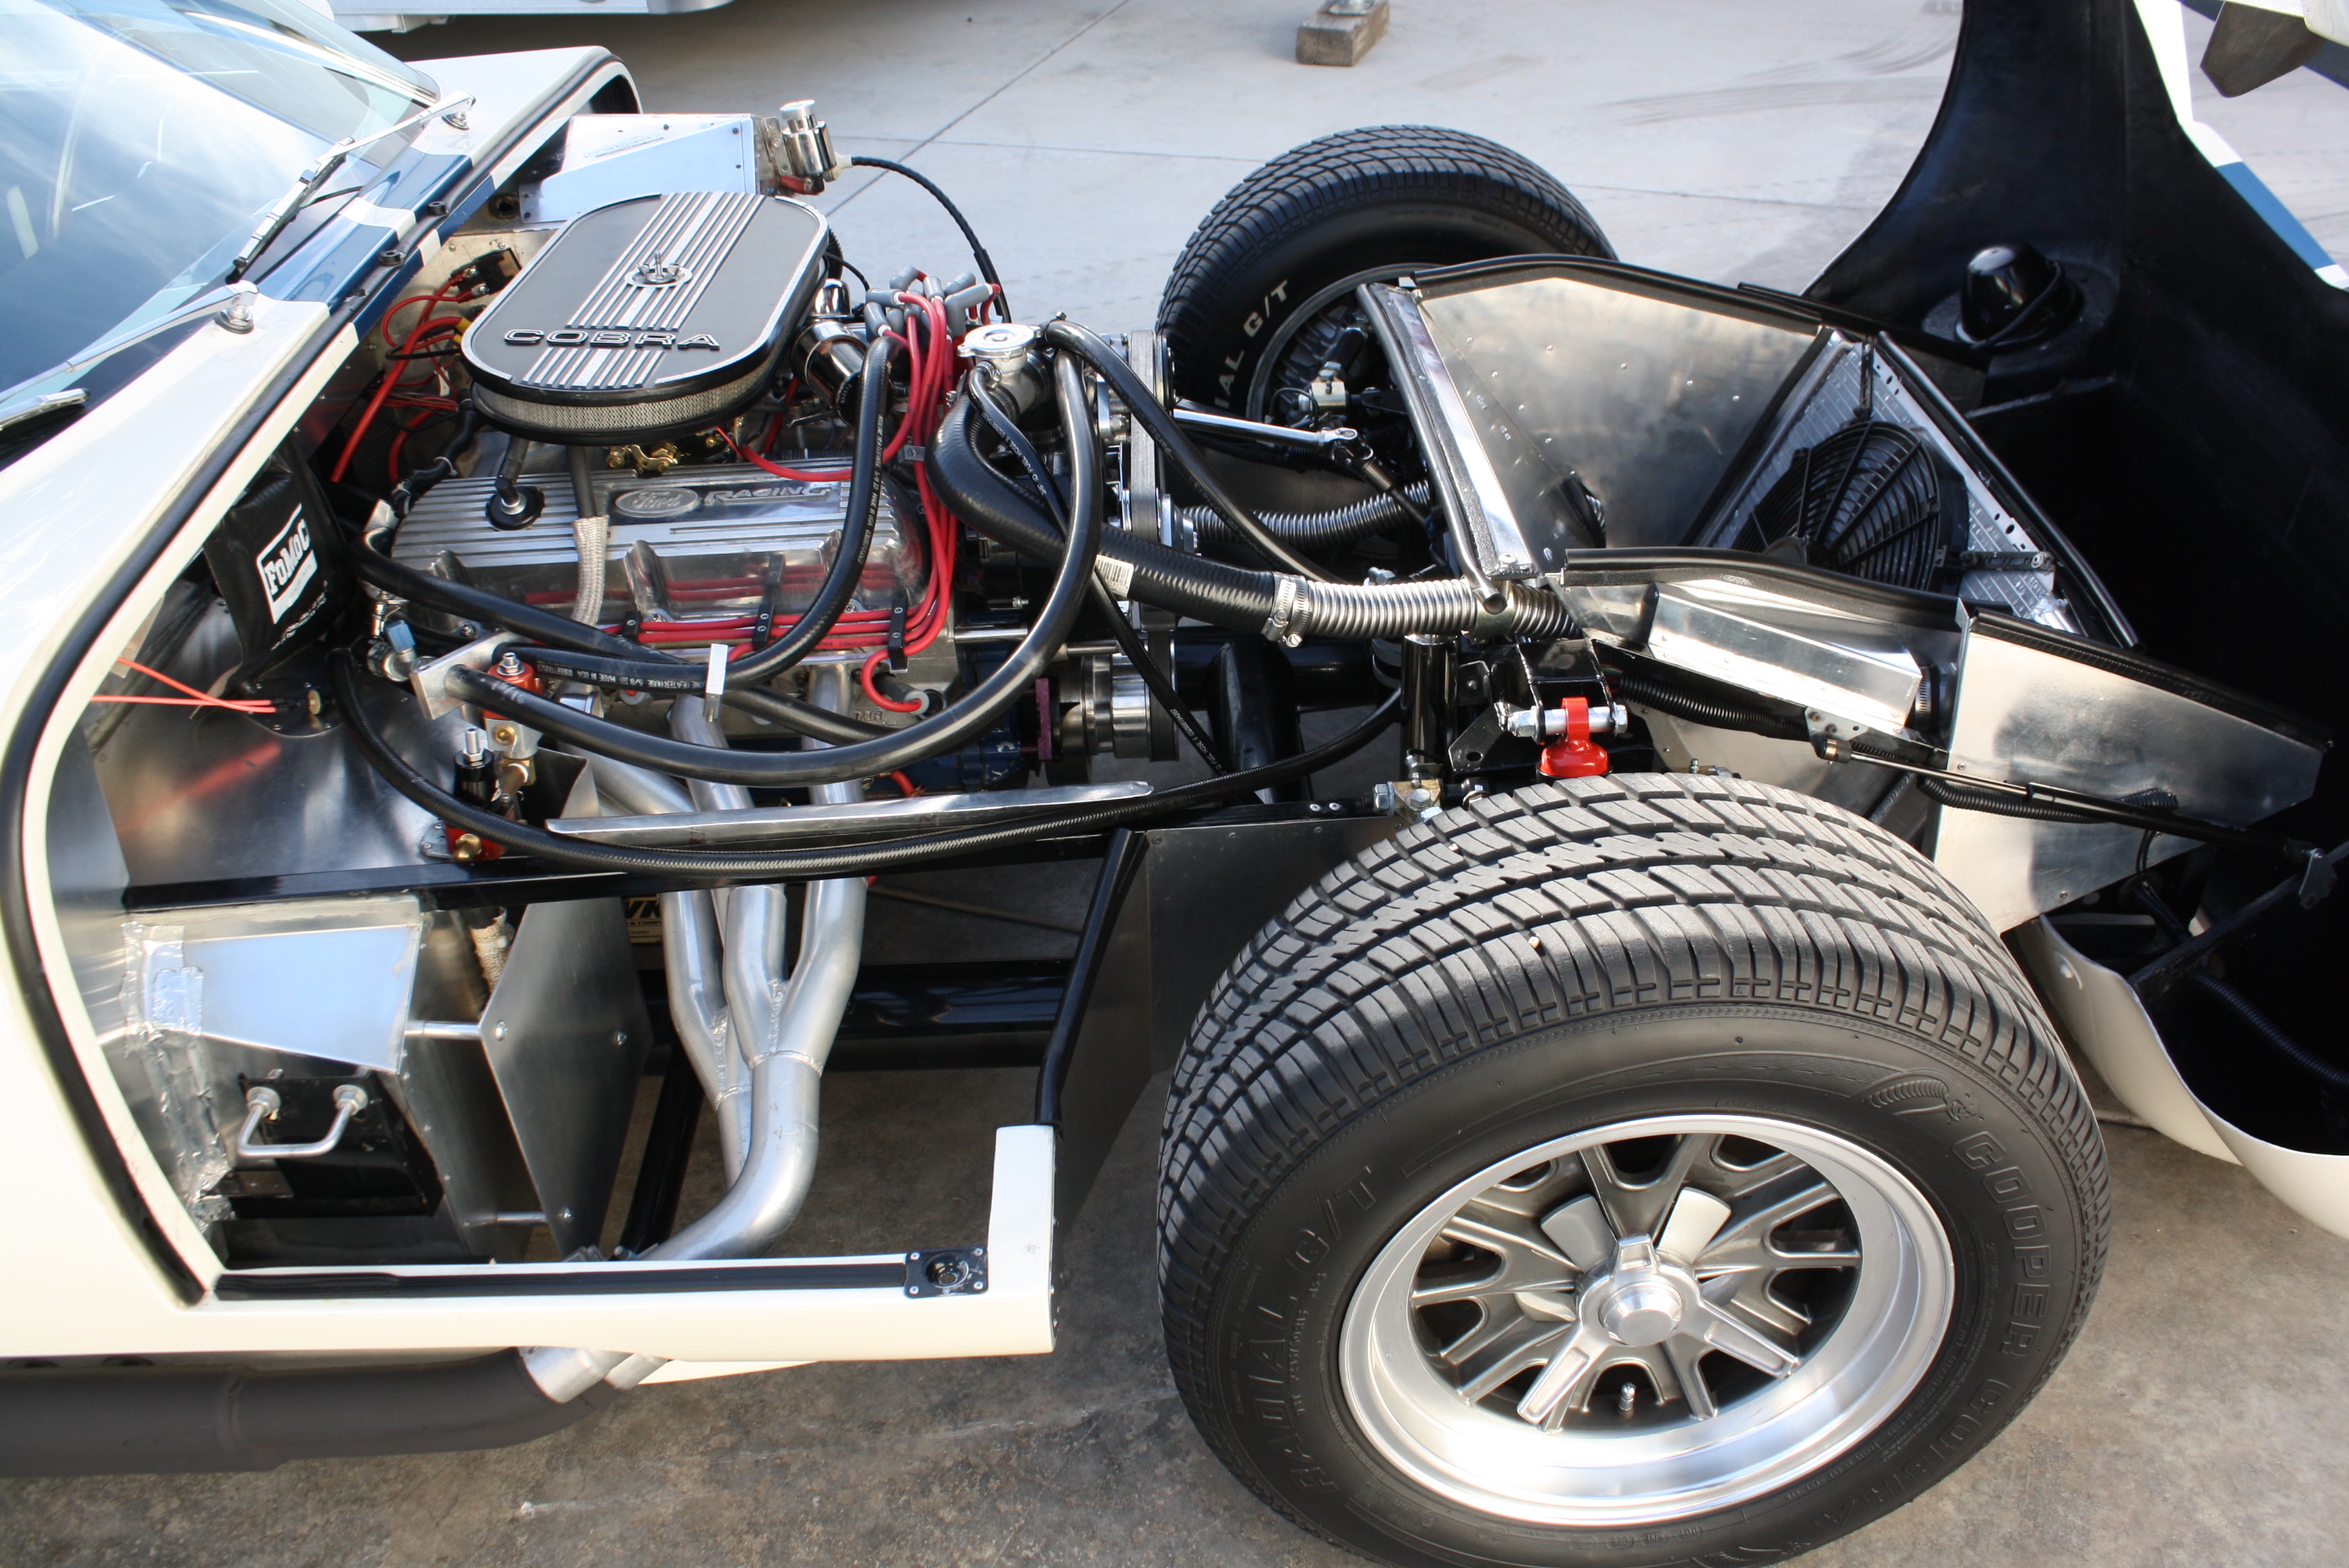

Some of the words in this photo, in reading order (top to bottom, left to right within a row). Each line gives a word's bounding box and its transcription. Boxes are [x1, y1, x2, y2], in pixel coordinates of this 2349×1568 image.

[1243, 279, 1288, 338] G/T
[504, 329, 721, 351] COBRA
[1009, 440, 1023, 457] HOSE
[1021, 455, 1034, 473] FUEL
[631, 490, 682, 508] Ford
[704, 485, 830, 505] RACING
[576, 670, 590, 679] USA
[599, 673, 616, 683] MADE
[1195, 740, 1209, 753] HOSE
[1284, 1165, 1376, 1275] G/T
[1952, 1130, 2051, 1358] COOPER
[1249, 1296, 1340, 1495] RADIAL
[1812, 1377, 2011, 1531] COBRA
